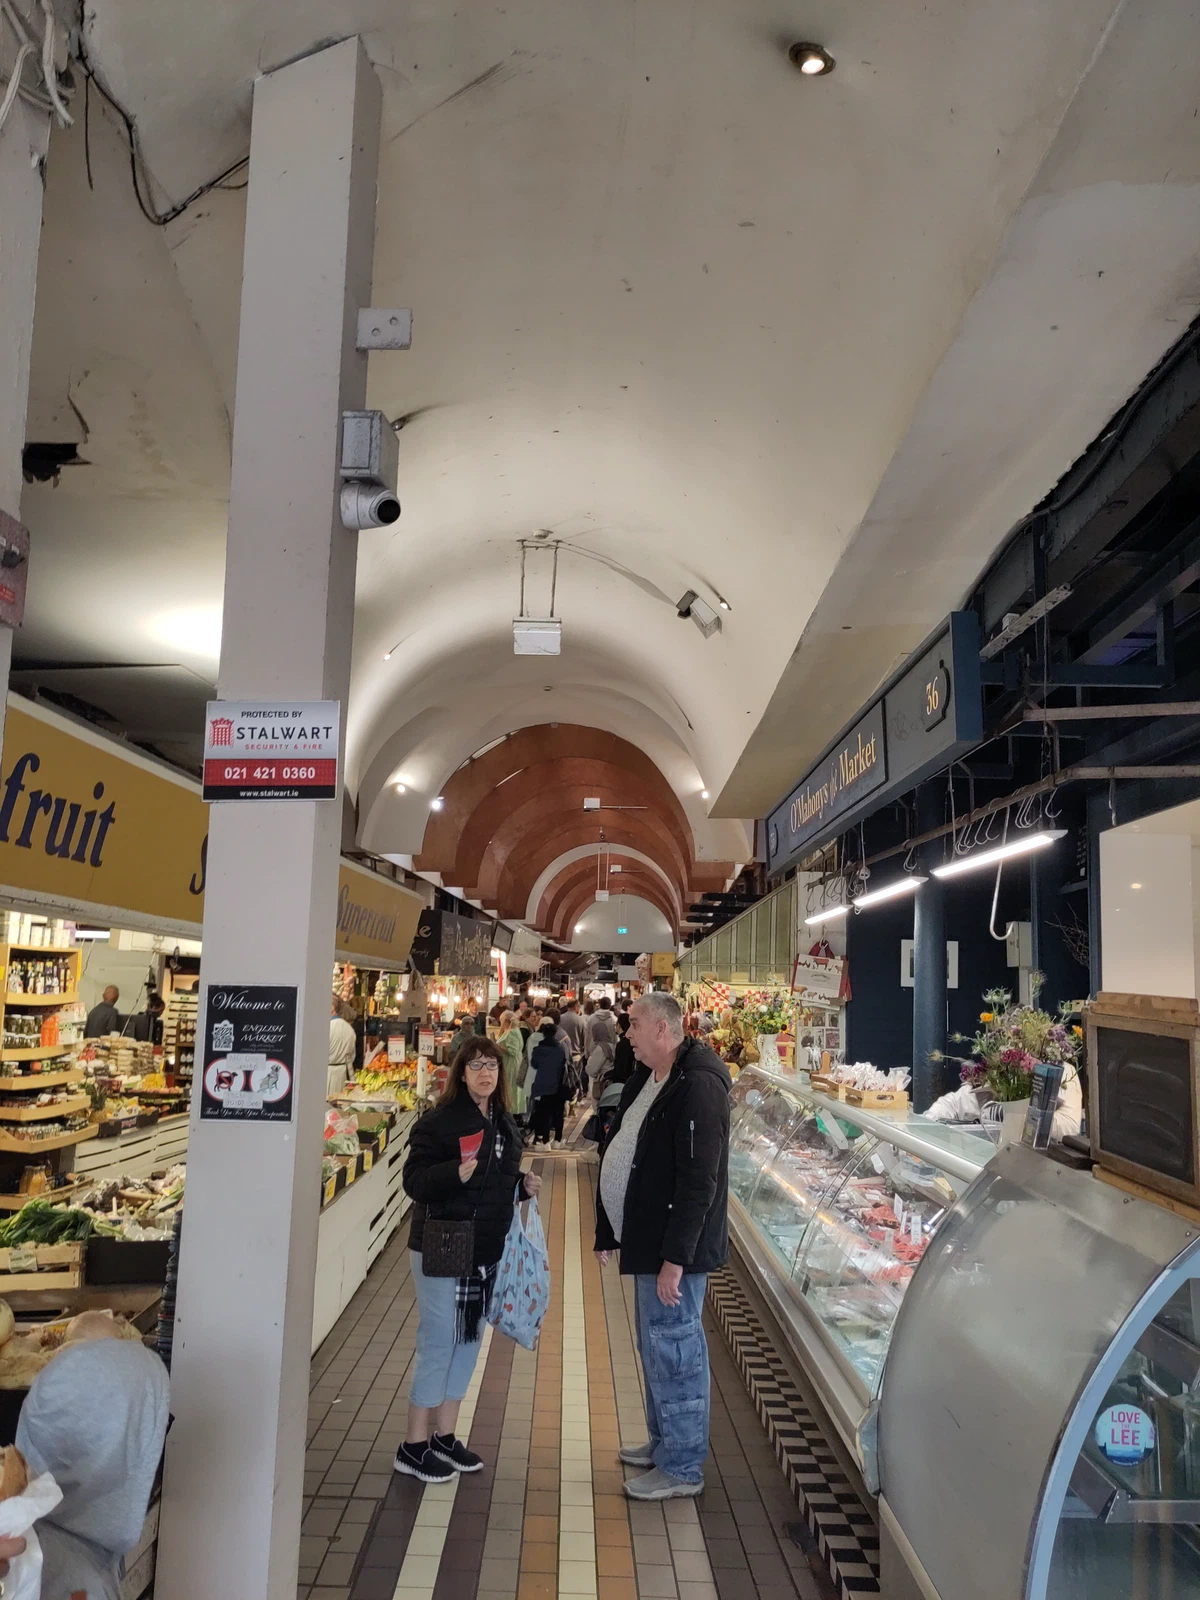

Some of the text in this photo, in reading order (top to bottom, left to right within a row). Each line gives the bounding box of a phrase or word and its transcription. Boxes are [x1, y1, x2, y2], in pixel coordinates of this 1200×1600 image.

[926, 676, 938, 715] 36
[236, 726, 333, 740] STALWART
[224, 767, 316, 779] 021 421 0360
[790, 783, 828, 833] O'Mahonys
[838, 732, 877, 791] Market
[0, 752, 116, 868] fruit
[212, 990, 286, 1010] Welcome to
[242, 1024, 284, 1034] ENGLISH
[240, 1034, 287, 1043] MARKET
[1111, 1411, 1141, 1424] LOVE
[1111, 1428, 1141, 1446] LEE
